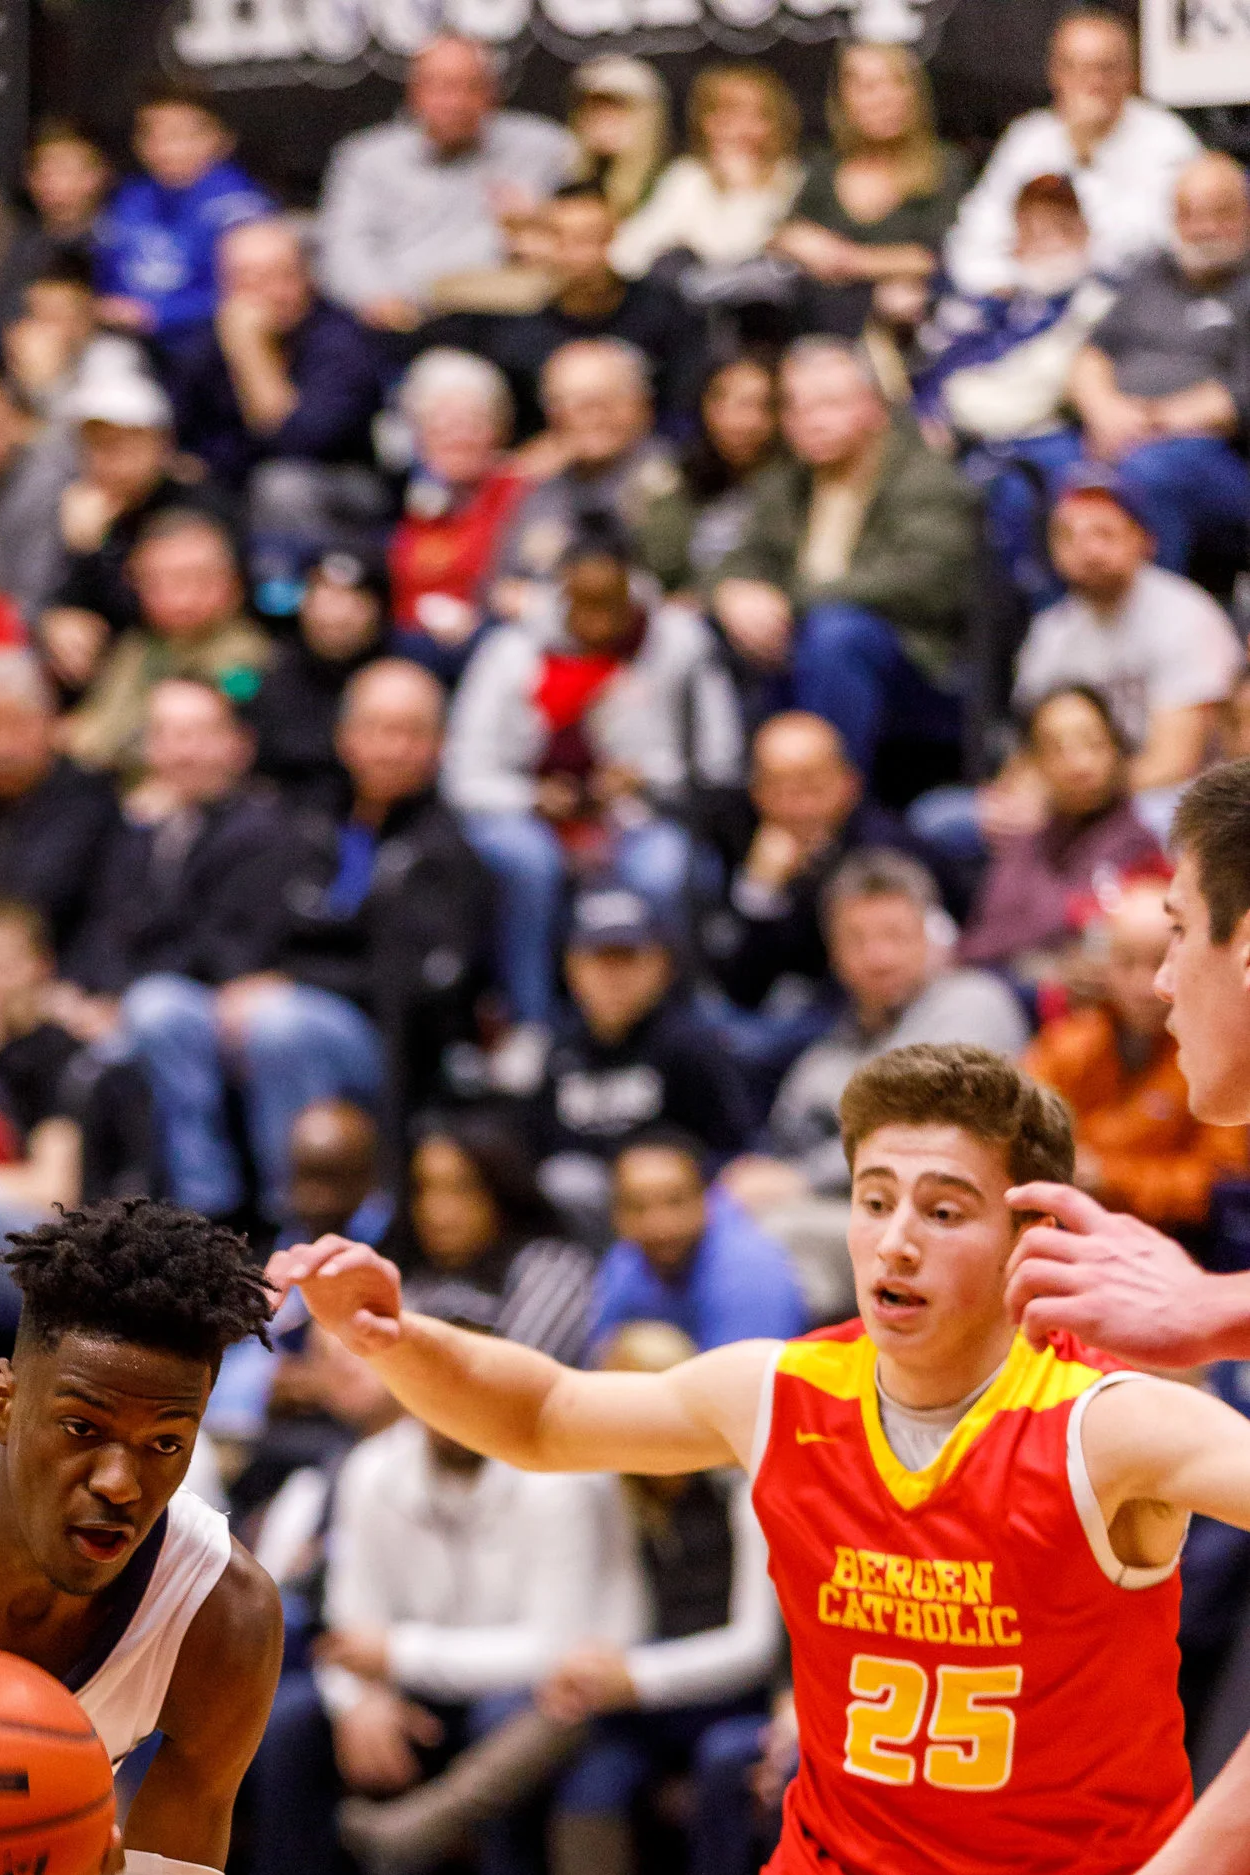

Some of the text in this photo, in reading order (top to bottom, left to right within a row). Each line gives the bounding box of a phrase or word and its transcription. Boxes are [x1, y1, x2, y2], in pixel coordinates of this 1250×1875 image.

[833, 1547, 993, 1604] BERGEN
[818, 1583, 1022, 1646] CATHOLIC
[844, 1654, 1023, 1791] 25
